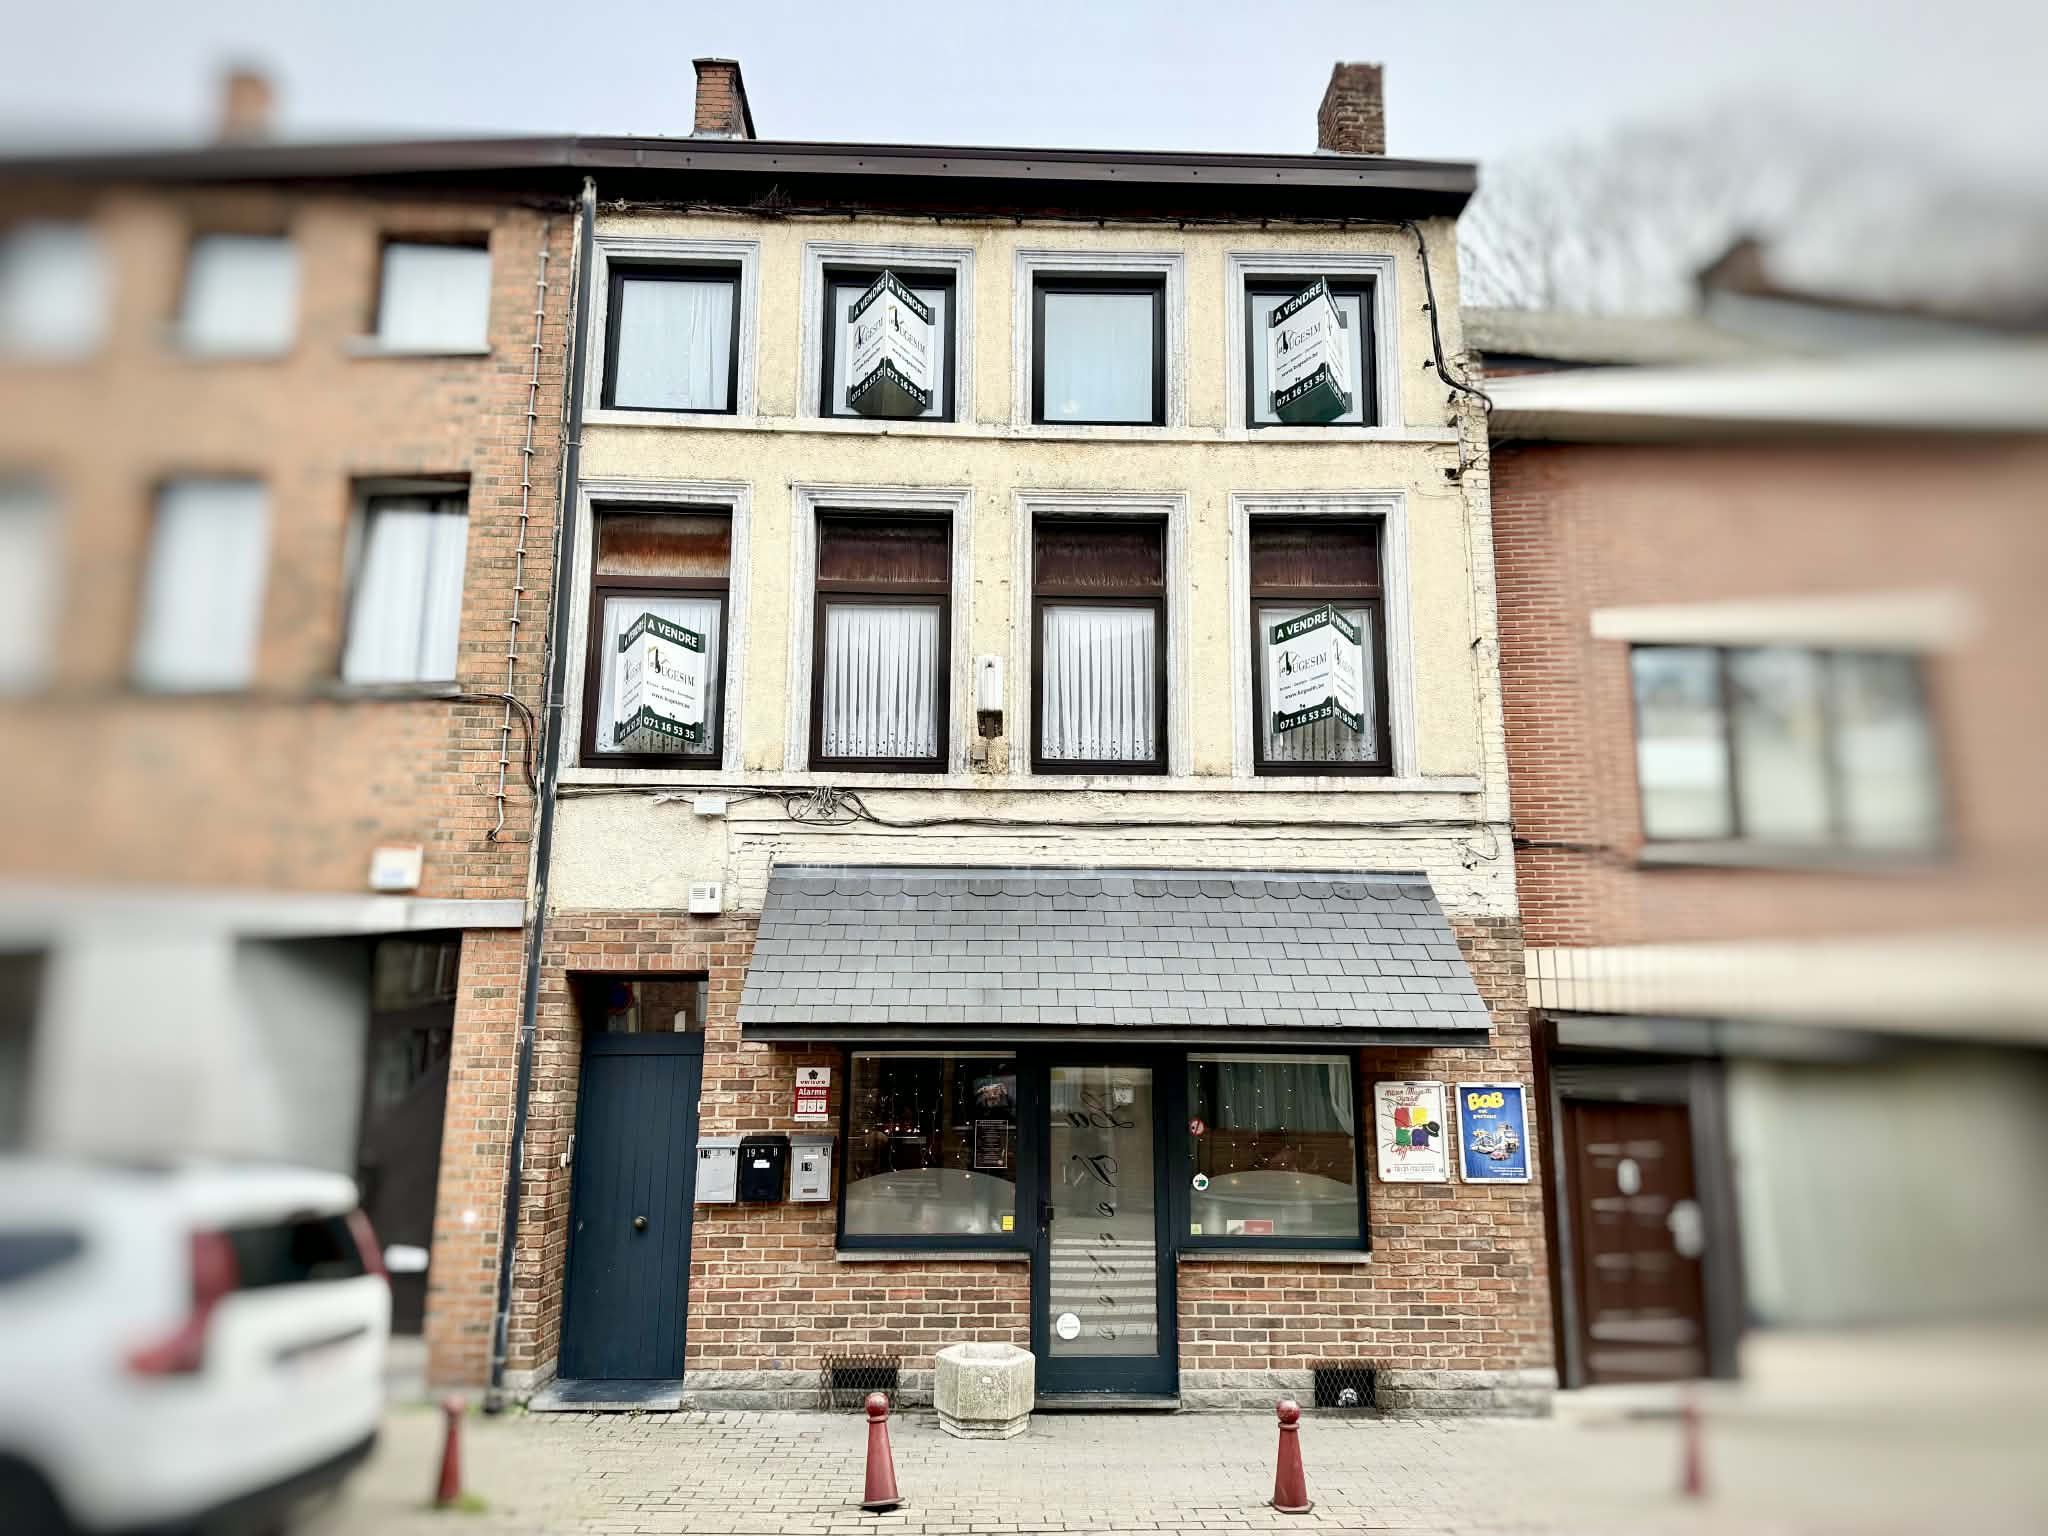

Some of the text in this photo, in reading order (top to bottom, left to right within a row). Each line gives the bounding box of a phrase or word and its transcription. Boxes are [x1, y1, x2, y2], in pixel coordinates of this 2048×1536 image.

[860, 278, 887, 309] VENDRE
[888, 279, 928, 320] A VENDRE
[1274, 311, 1282, 323] A
[1283, 282, 1322, 316] VENDRE
[1276, 371, 1326, 407] 071 16 53 35
[648, 619, 698, 648] A VENDRE
[1276, 612, 1328, 640] A VENDRE
[643, 715, 659, 728] 071
[661, 720, 672, 732] 16
[673, 724, 684, 735] 53
[685, 727, 695, 739] 35
[1280, 706, 1332, 730] 071 16 53 35
[798, 1087, 827, 1096] Alarme
[746, 1148, 756, 1158] 19
